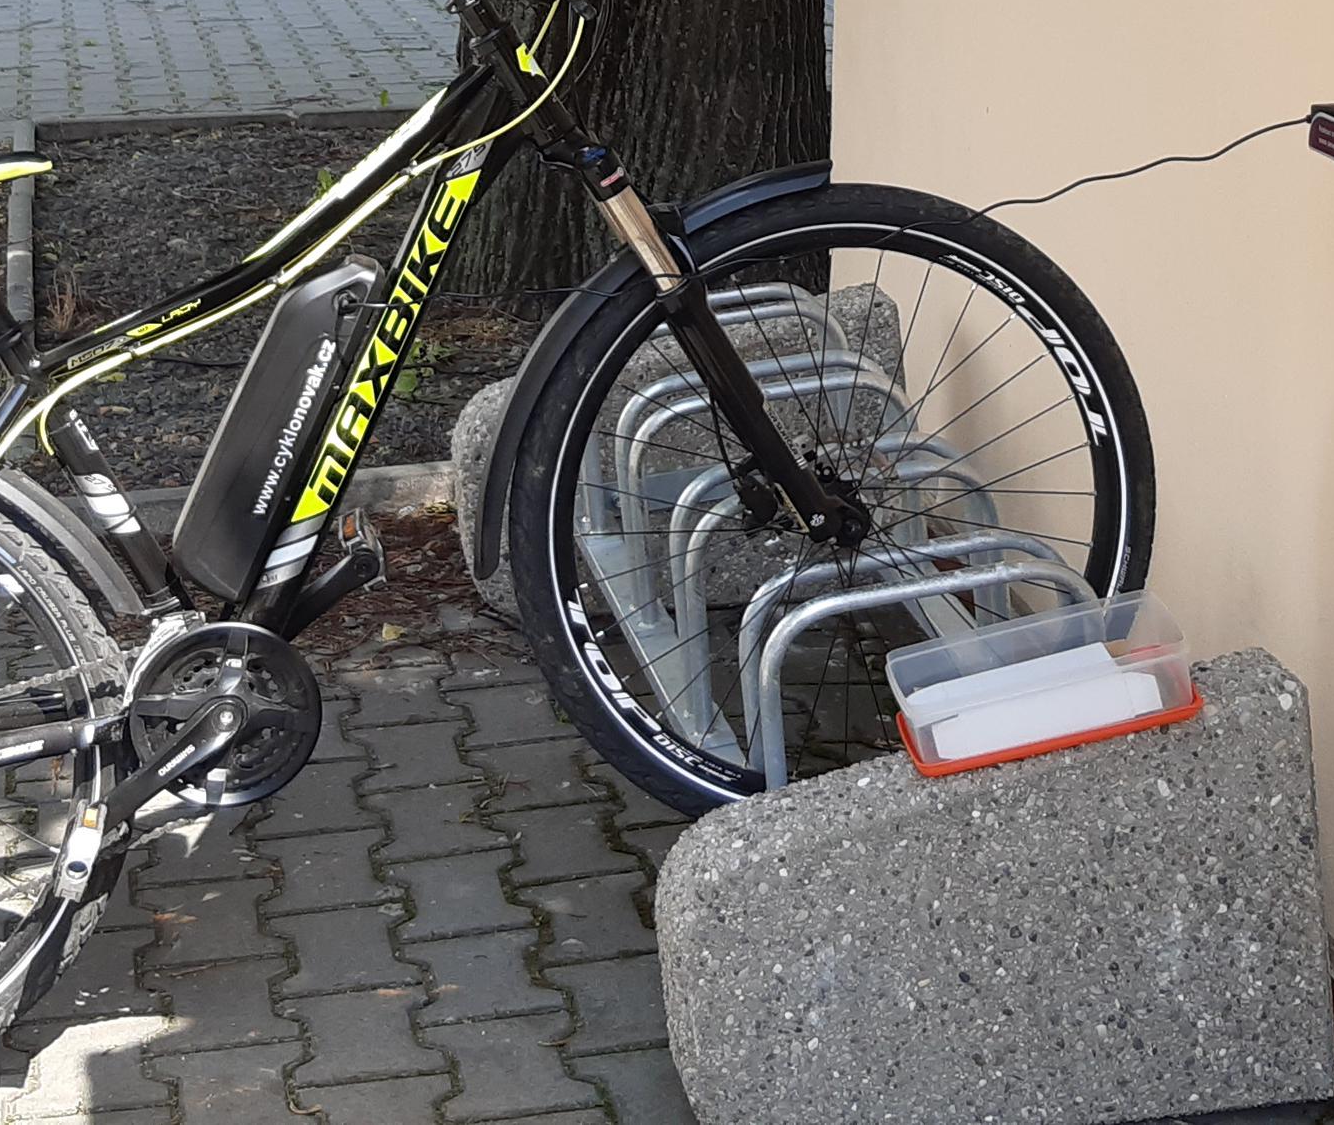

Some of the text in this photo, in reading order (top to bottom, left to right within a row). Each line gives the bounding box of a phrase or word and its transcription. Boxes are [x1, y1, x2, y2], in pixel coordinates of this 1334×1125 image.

[161, 298, 201, 323] LADY
[981, 269, 1026, 305] DISC
[307, 181, 467, 508] MAXBIKE
[252, 338, 337, 516] www.cyklonovak.cz
[17, 565, 37, 586] LAND
[60, 619, 77, 642] PLUS
[653, 734, 703, 768] DISC
